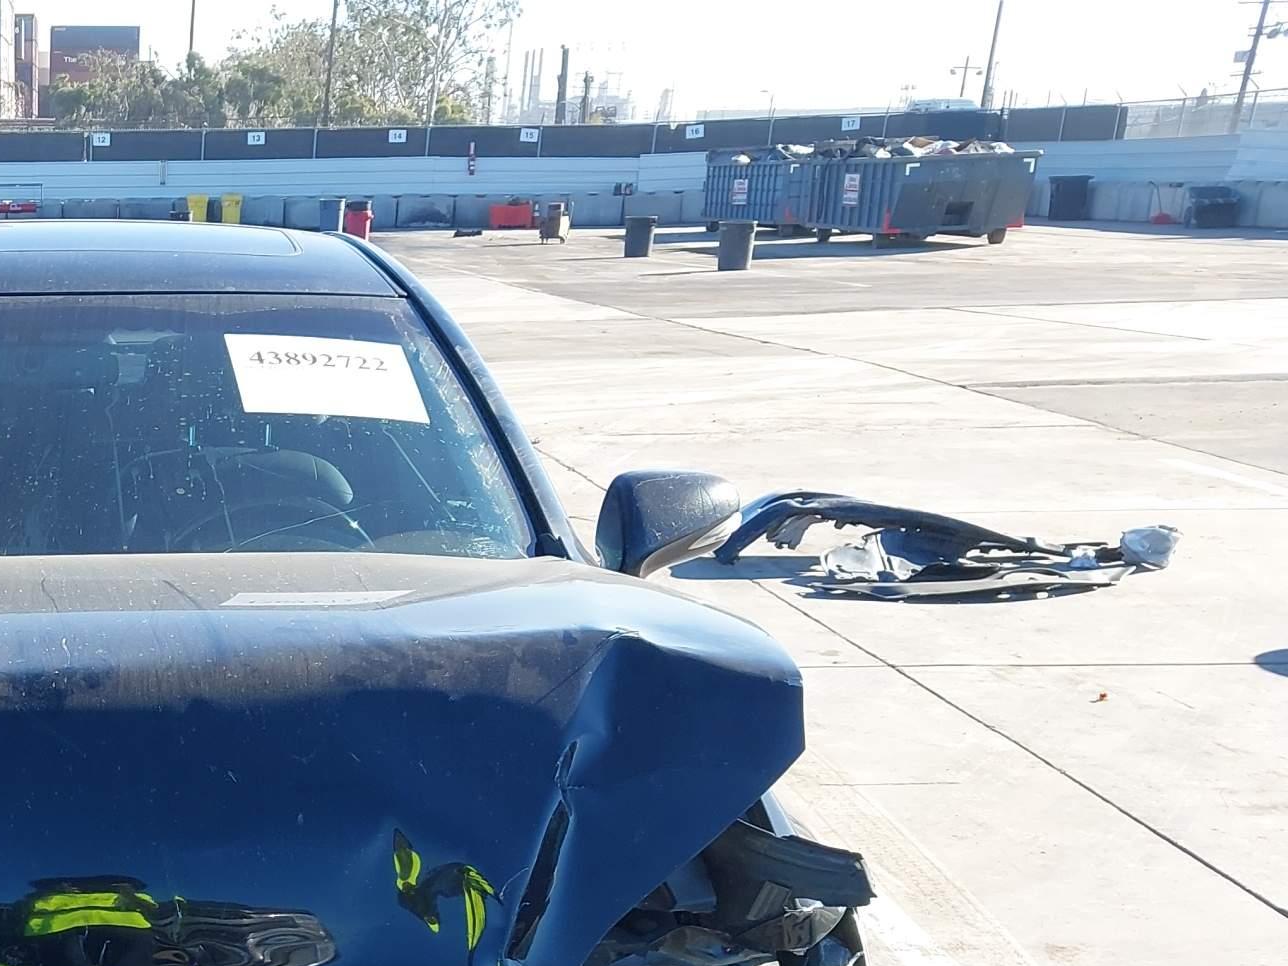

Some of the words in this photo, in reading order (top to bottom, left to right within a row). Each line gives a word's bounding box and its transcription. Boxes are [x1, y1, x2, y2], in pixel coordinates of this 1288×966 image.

[847, 119, 855, 127] 17
[97, 136, 106, 144] 12
[252, 134, 261, 142] 13
[393, 132, 402, 140] 14
[248, 350, 388, 372] 43892722
